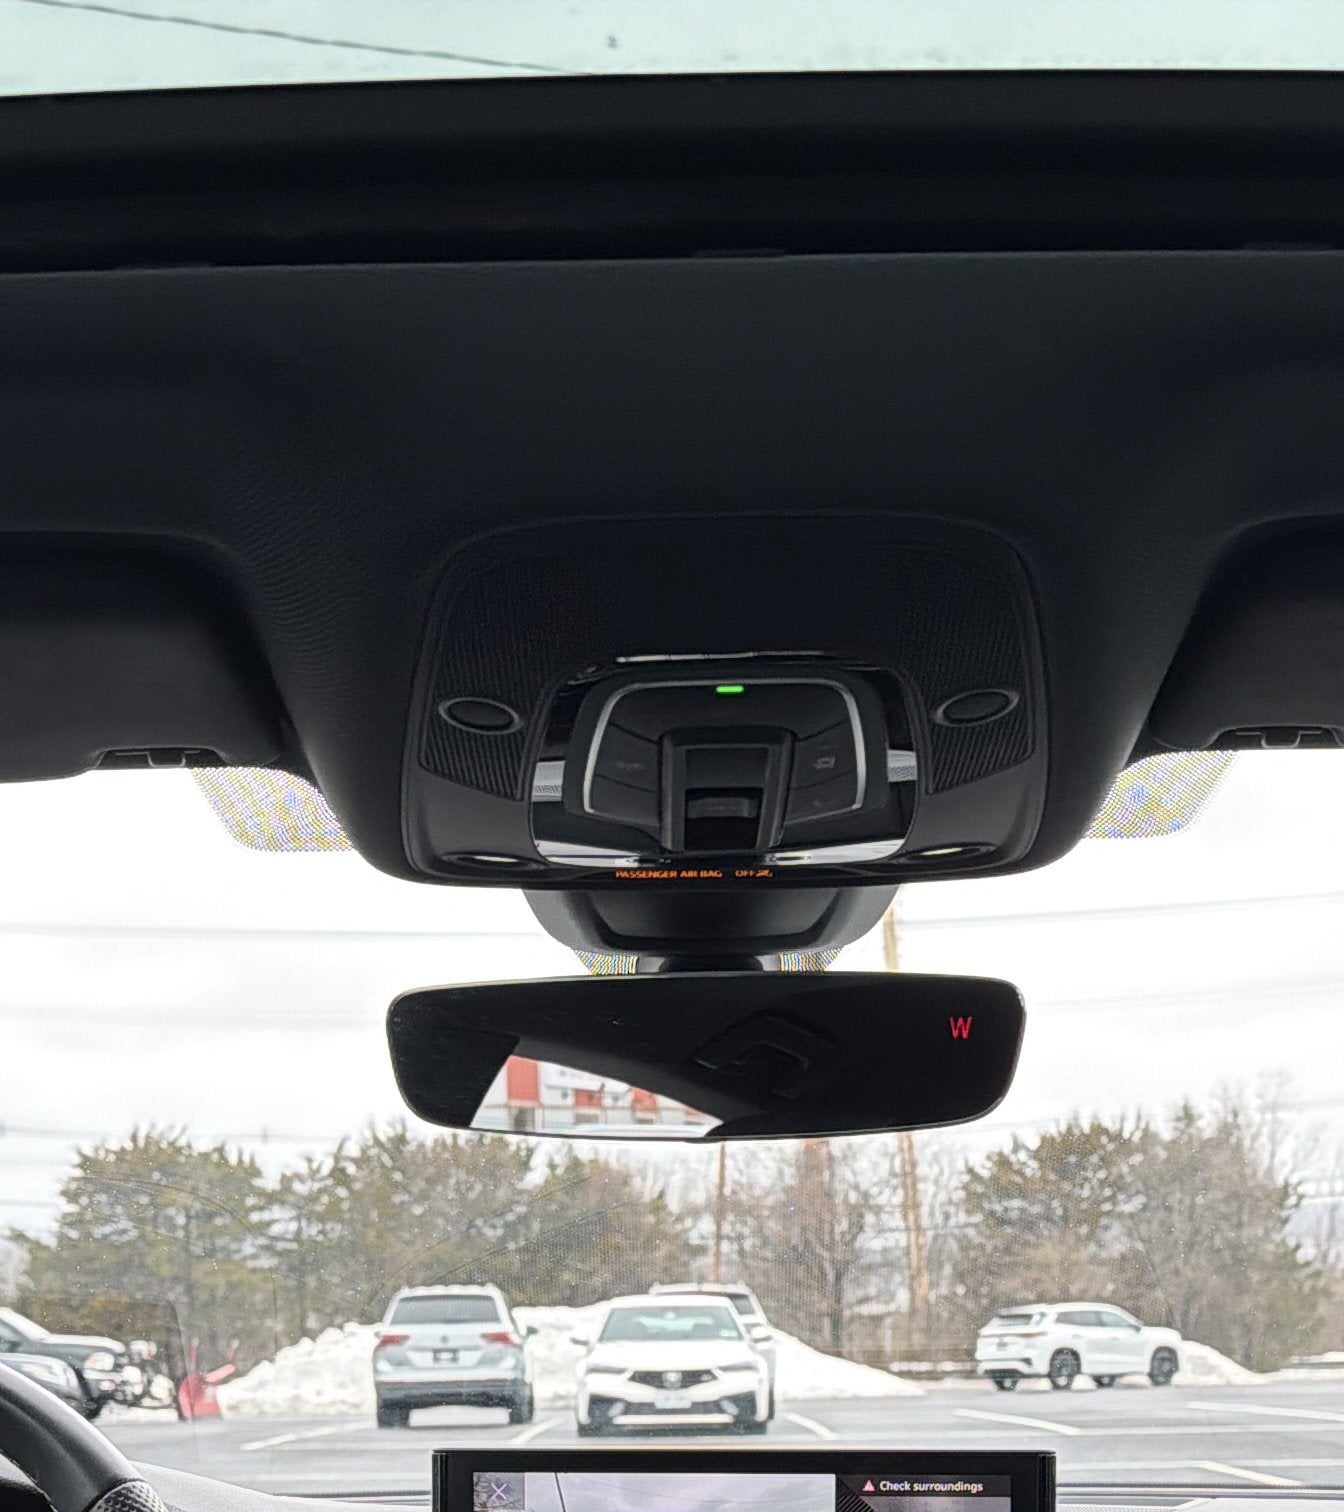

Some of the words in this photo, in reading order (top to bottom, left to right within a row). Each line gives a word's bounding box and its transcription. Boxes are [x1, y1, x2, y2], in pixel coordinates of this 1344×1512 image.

[615, 869, 678, 879] PASSENGER
[680, 870, 698, 878] AIR
[700, 870, 723, 878] BAG
[949, 1016, 973, 1040] W
[879, 1481, 911, 1491] Check
[913, 1481, 984, 1494] surroundings
